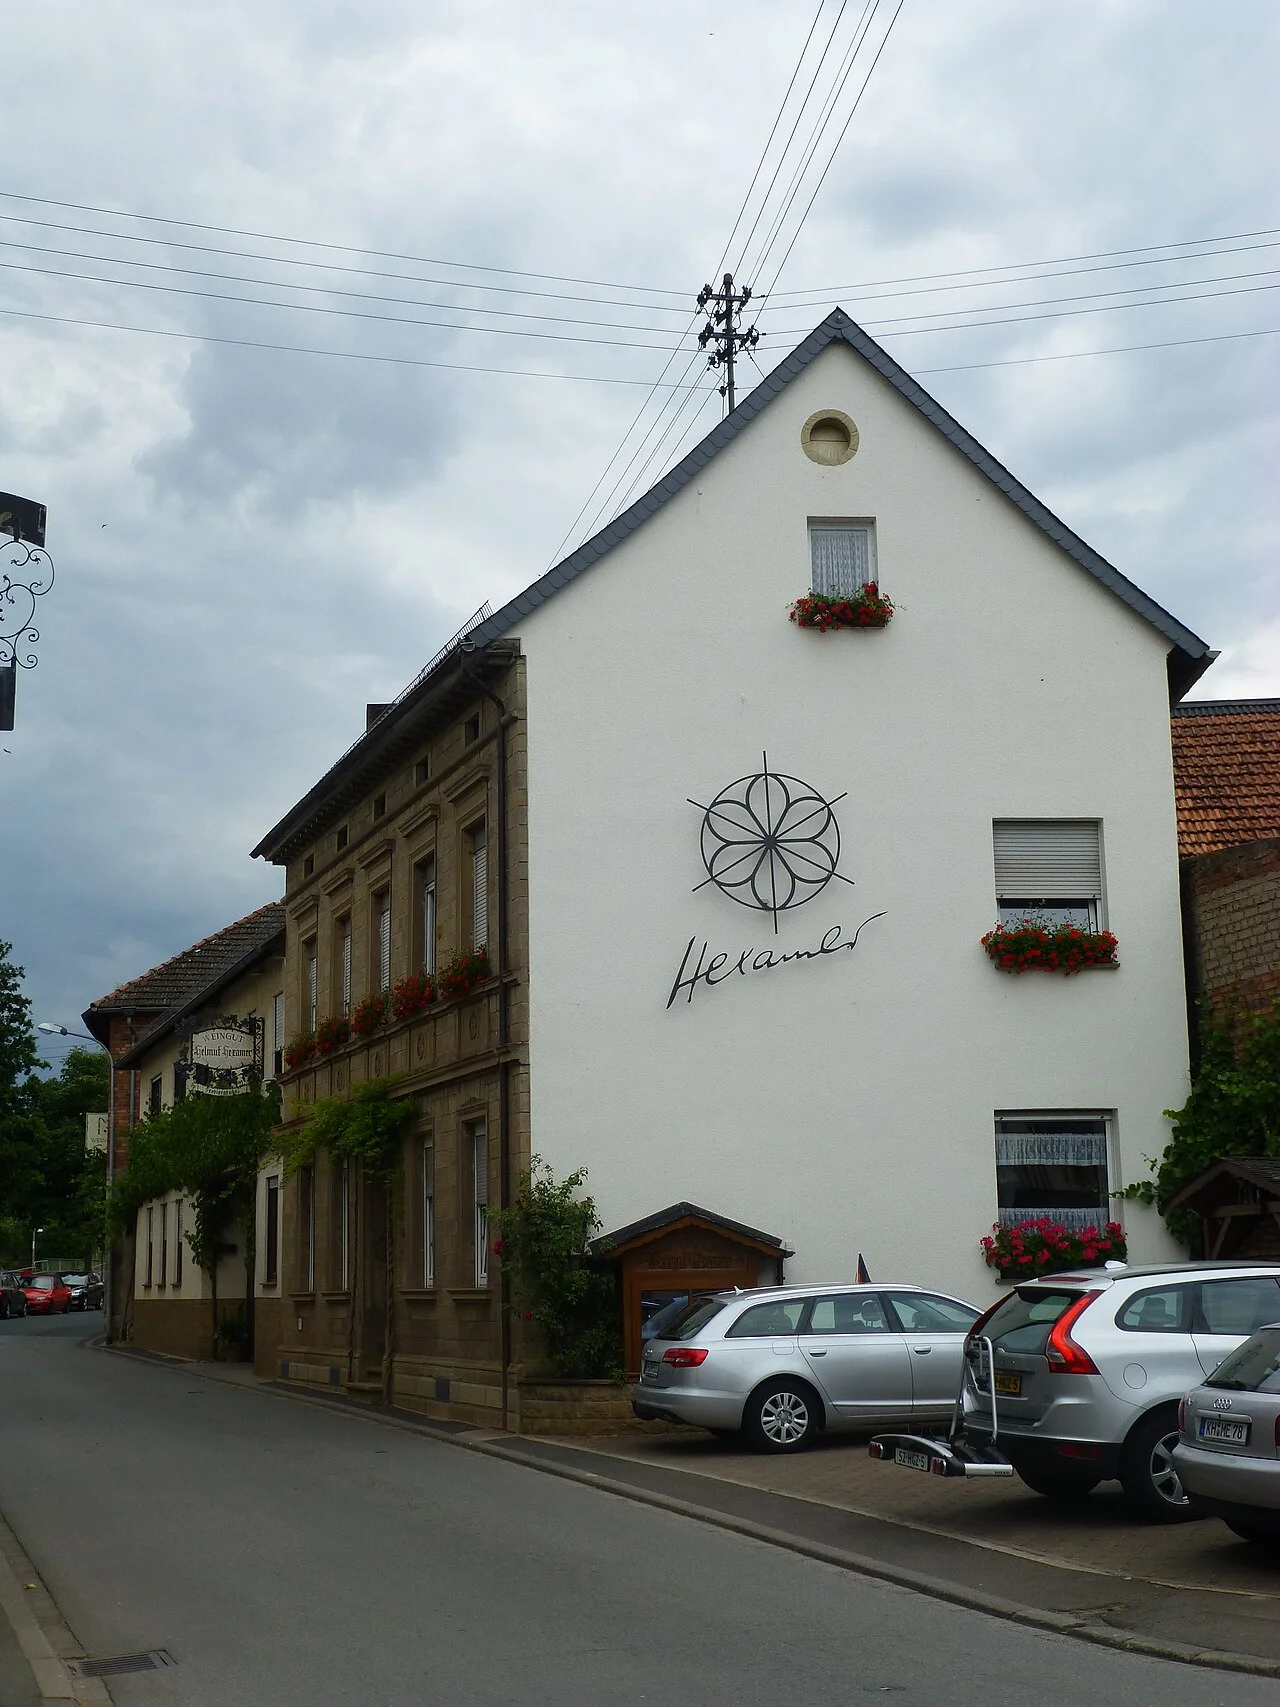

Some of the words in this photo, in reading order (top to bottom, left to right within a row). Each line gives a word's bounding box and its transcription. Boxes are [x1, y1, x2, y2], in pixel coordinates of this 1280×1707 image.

[666, 911, 888, 1009] Hexamer
[202, 1032, 245, 1043] WEINGUT
[194, 1044, 222, 1059] Helmut
[222, 1045, 253, 1059] Hexamer
[1206, 1421, 1216, 1435] KH
[1233, 1425, 1243, 1439] 78
